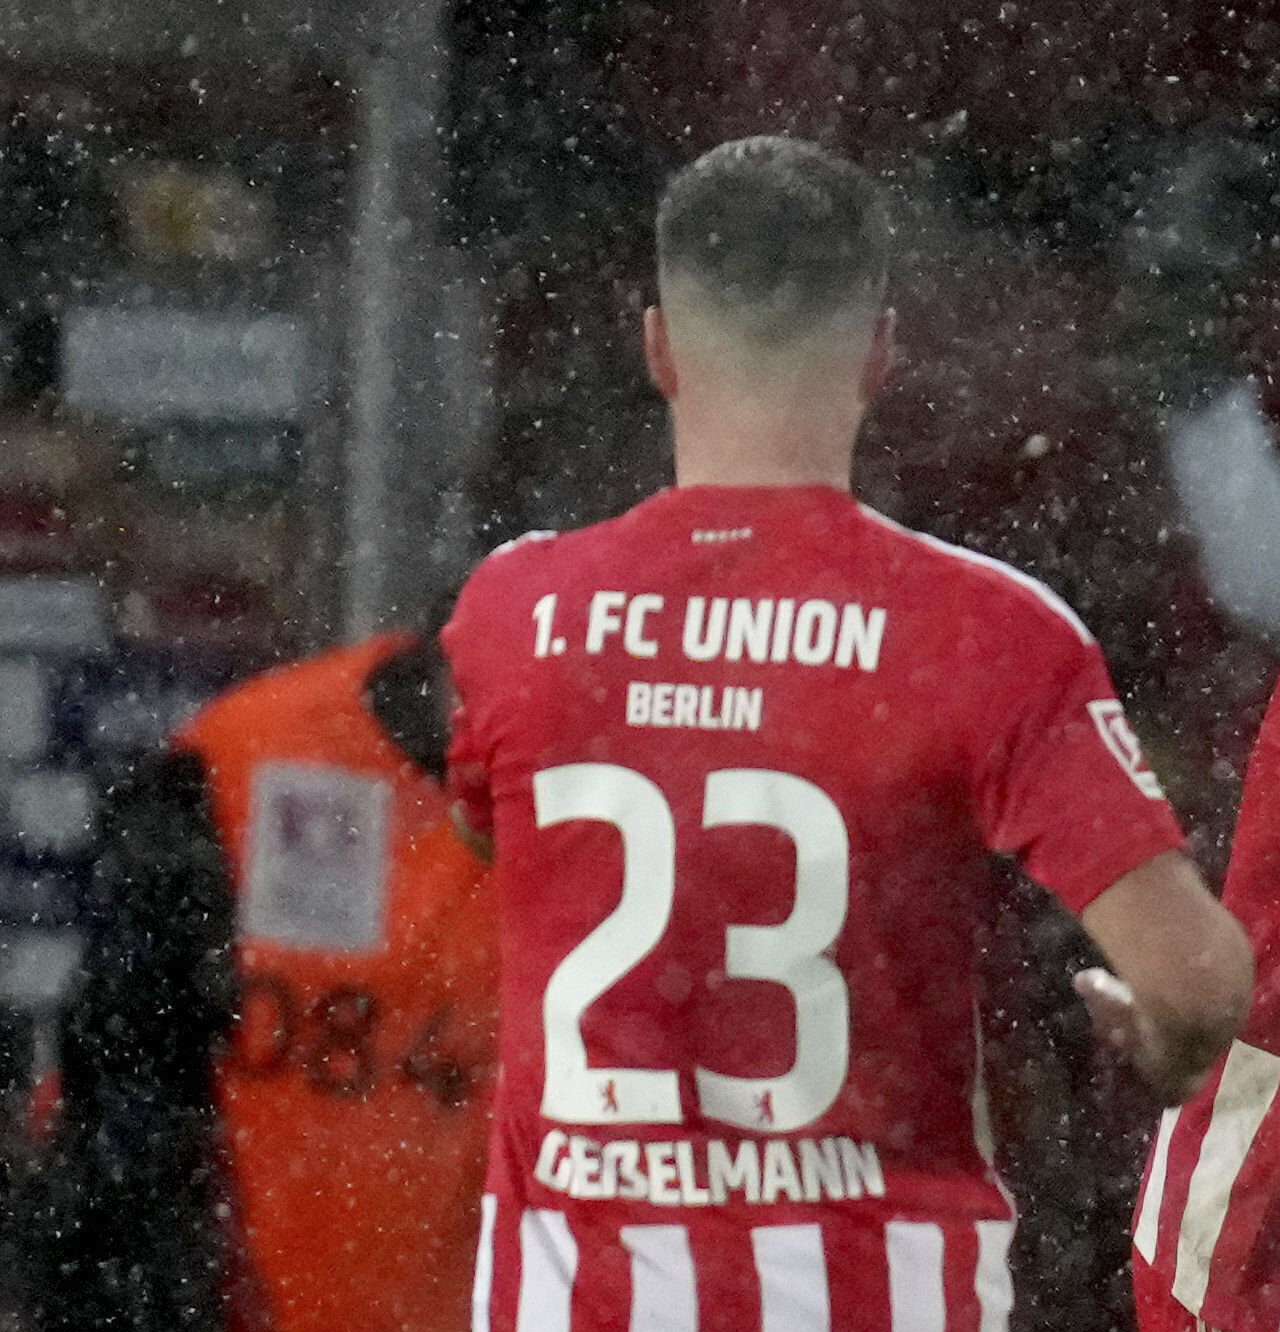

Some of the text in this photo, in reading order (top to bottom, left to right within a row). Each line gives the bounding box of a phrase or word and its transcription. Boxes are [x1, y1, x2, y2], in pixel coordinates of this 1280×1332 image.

[532, 590, 886, 673] 1. FC UNION
[626, 680, 762, 732] BERLIN
[532, 761, 851, 1134] 23
